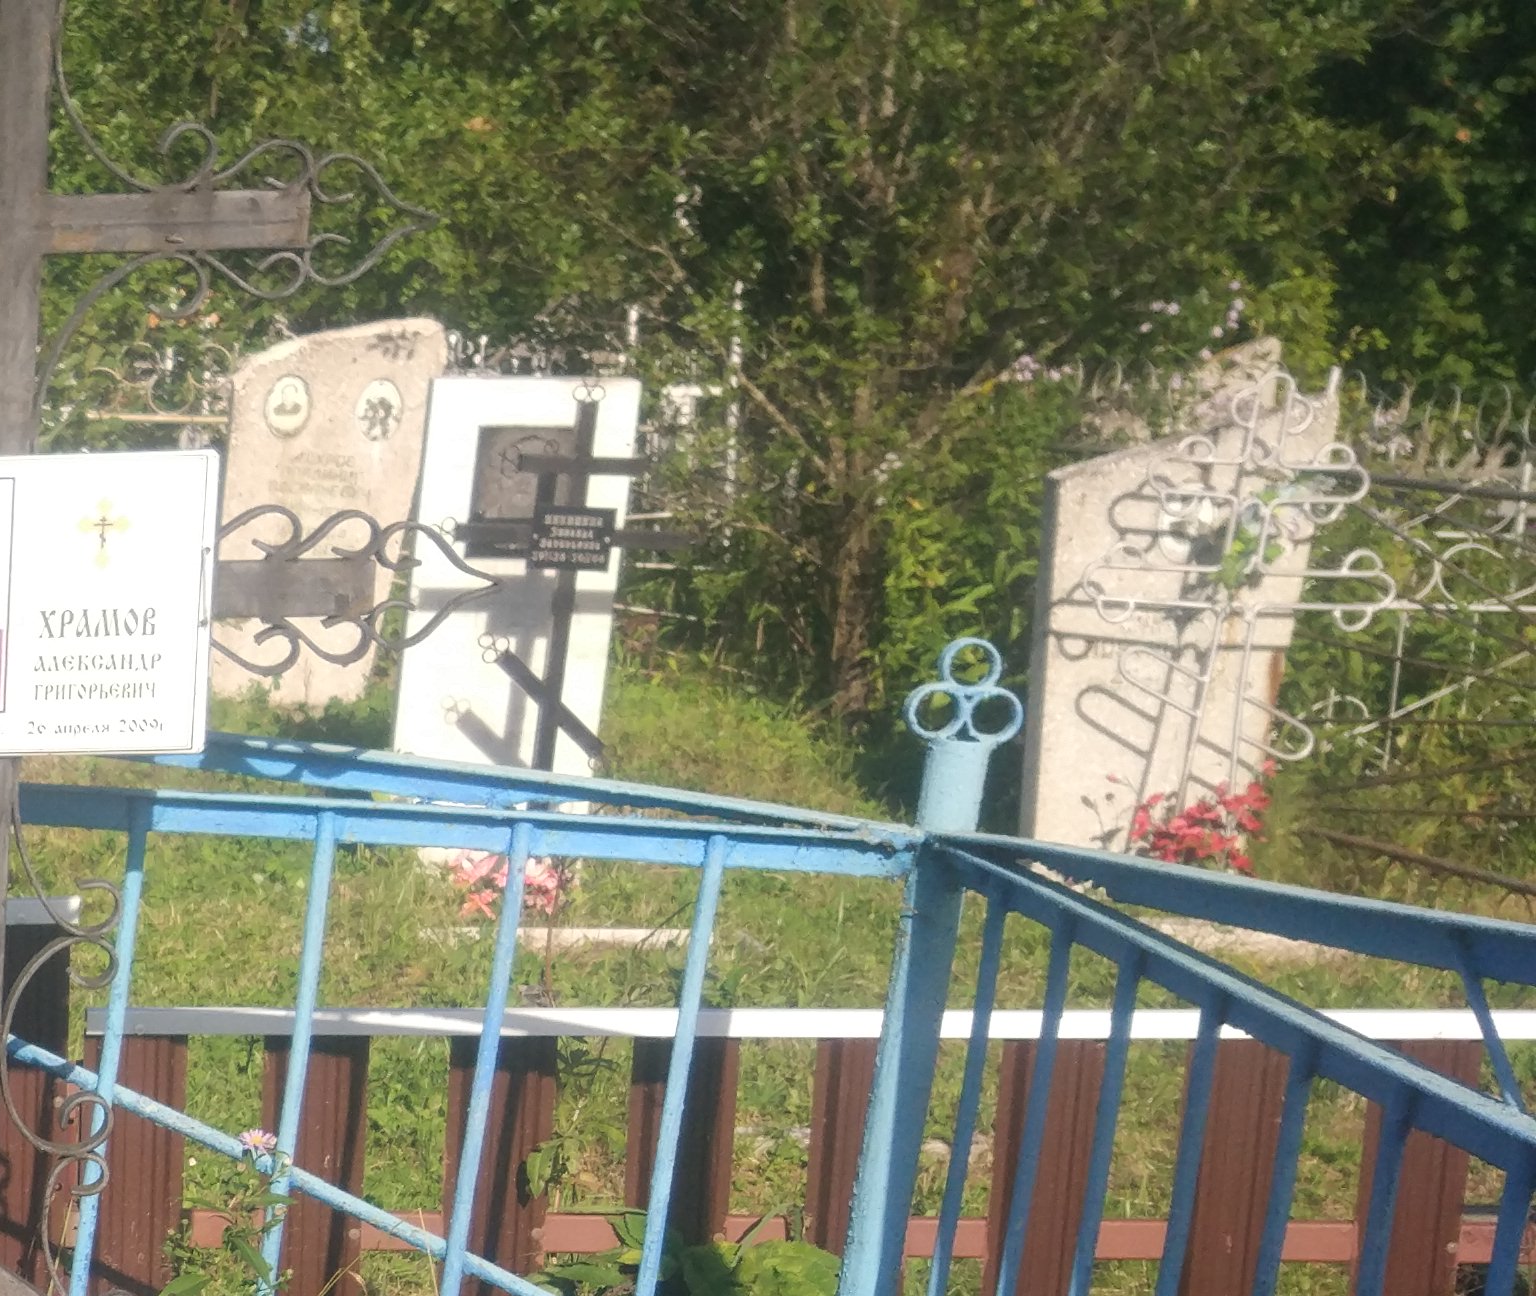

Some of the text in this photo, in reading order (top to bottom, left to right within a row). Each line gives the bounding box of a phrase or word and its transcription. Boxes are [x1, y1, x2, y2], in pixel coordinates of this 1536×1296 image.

[39, 607, 156, 639] ХРАМОВ
[33, 653, 162, 672] АЛЕКСАНДР
[33, 681, 156, 701] ГРИГОРЬЕВИЧ
